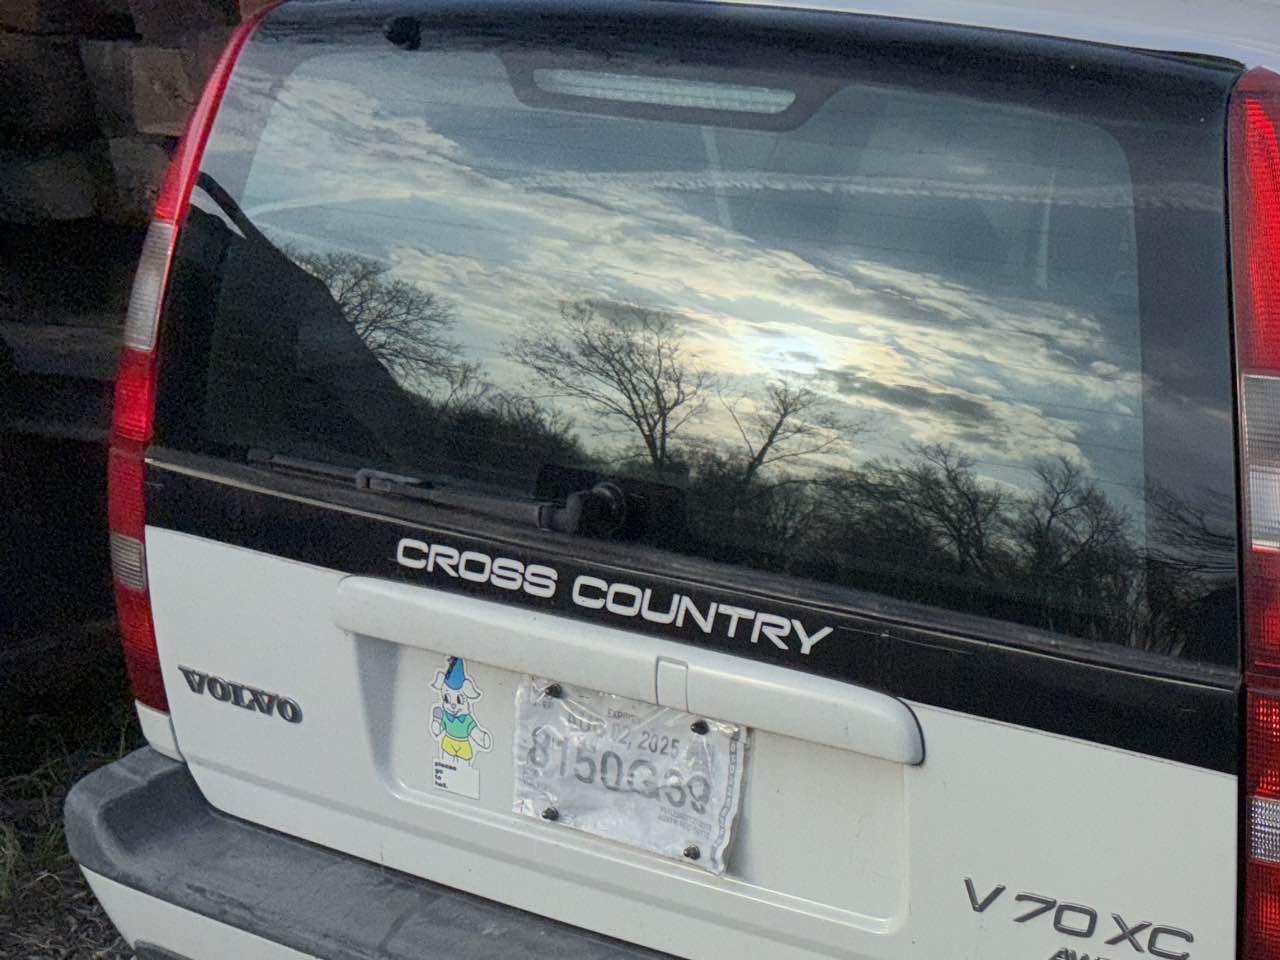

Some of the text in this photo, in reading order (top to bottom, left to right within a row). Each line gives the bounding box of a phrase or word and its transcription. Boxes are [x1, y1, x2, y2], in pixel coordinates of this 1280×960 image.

[397, 538, 834, 655] CROSS COUNTRY
[178, 665, 303, 723] VOLVO
[638, 730, 681, 759] 2025
[1104, 911, 1195, 960] XC
